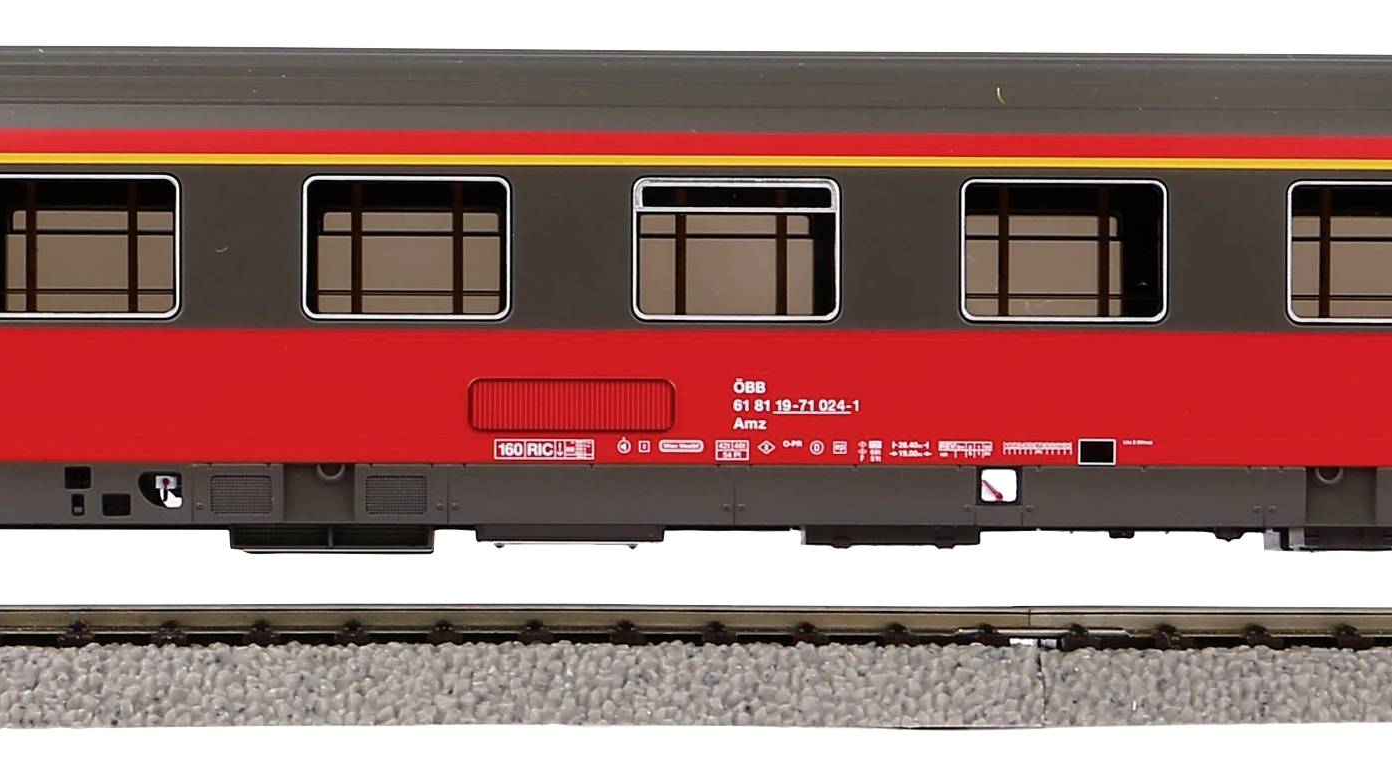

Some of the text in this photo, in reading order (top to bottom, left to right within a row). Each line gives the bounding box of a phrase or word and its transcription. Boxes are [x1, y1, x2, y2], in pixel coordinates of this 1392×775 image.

[733, 378, 766, 394] ÖBB
[733, 399, 860, 412] 61 81 19-71 024-1
[733, 417, 767, 430] Amz
[498, 442, 524, 457] 160
[527, 442, 554, 457] RIC
